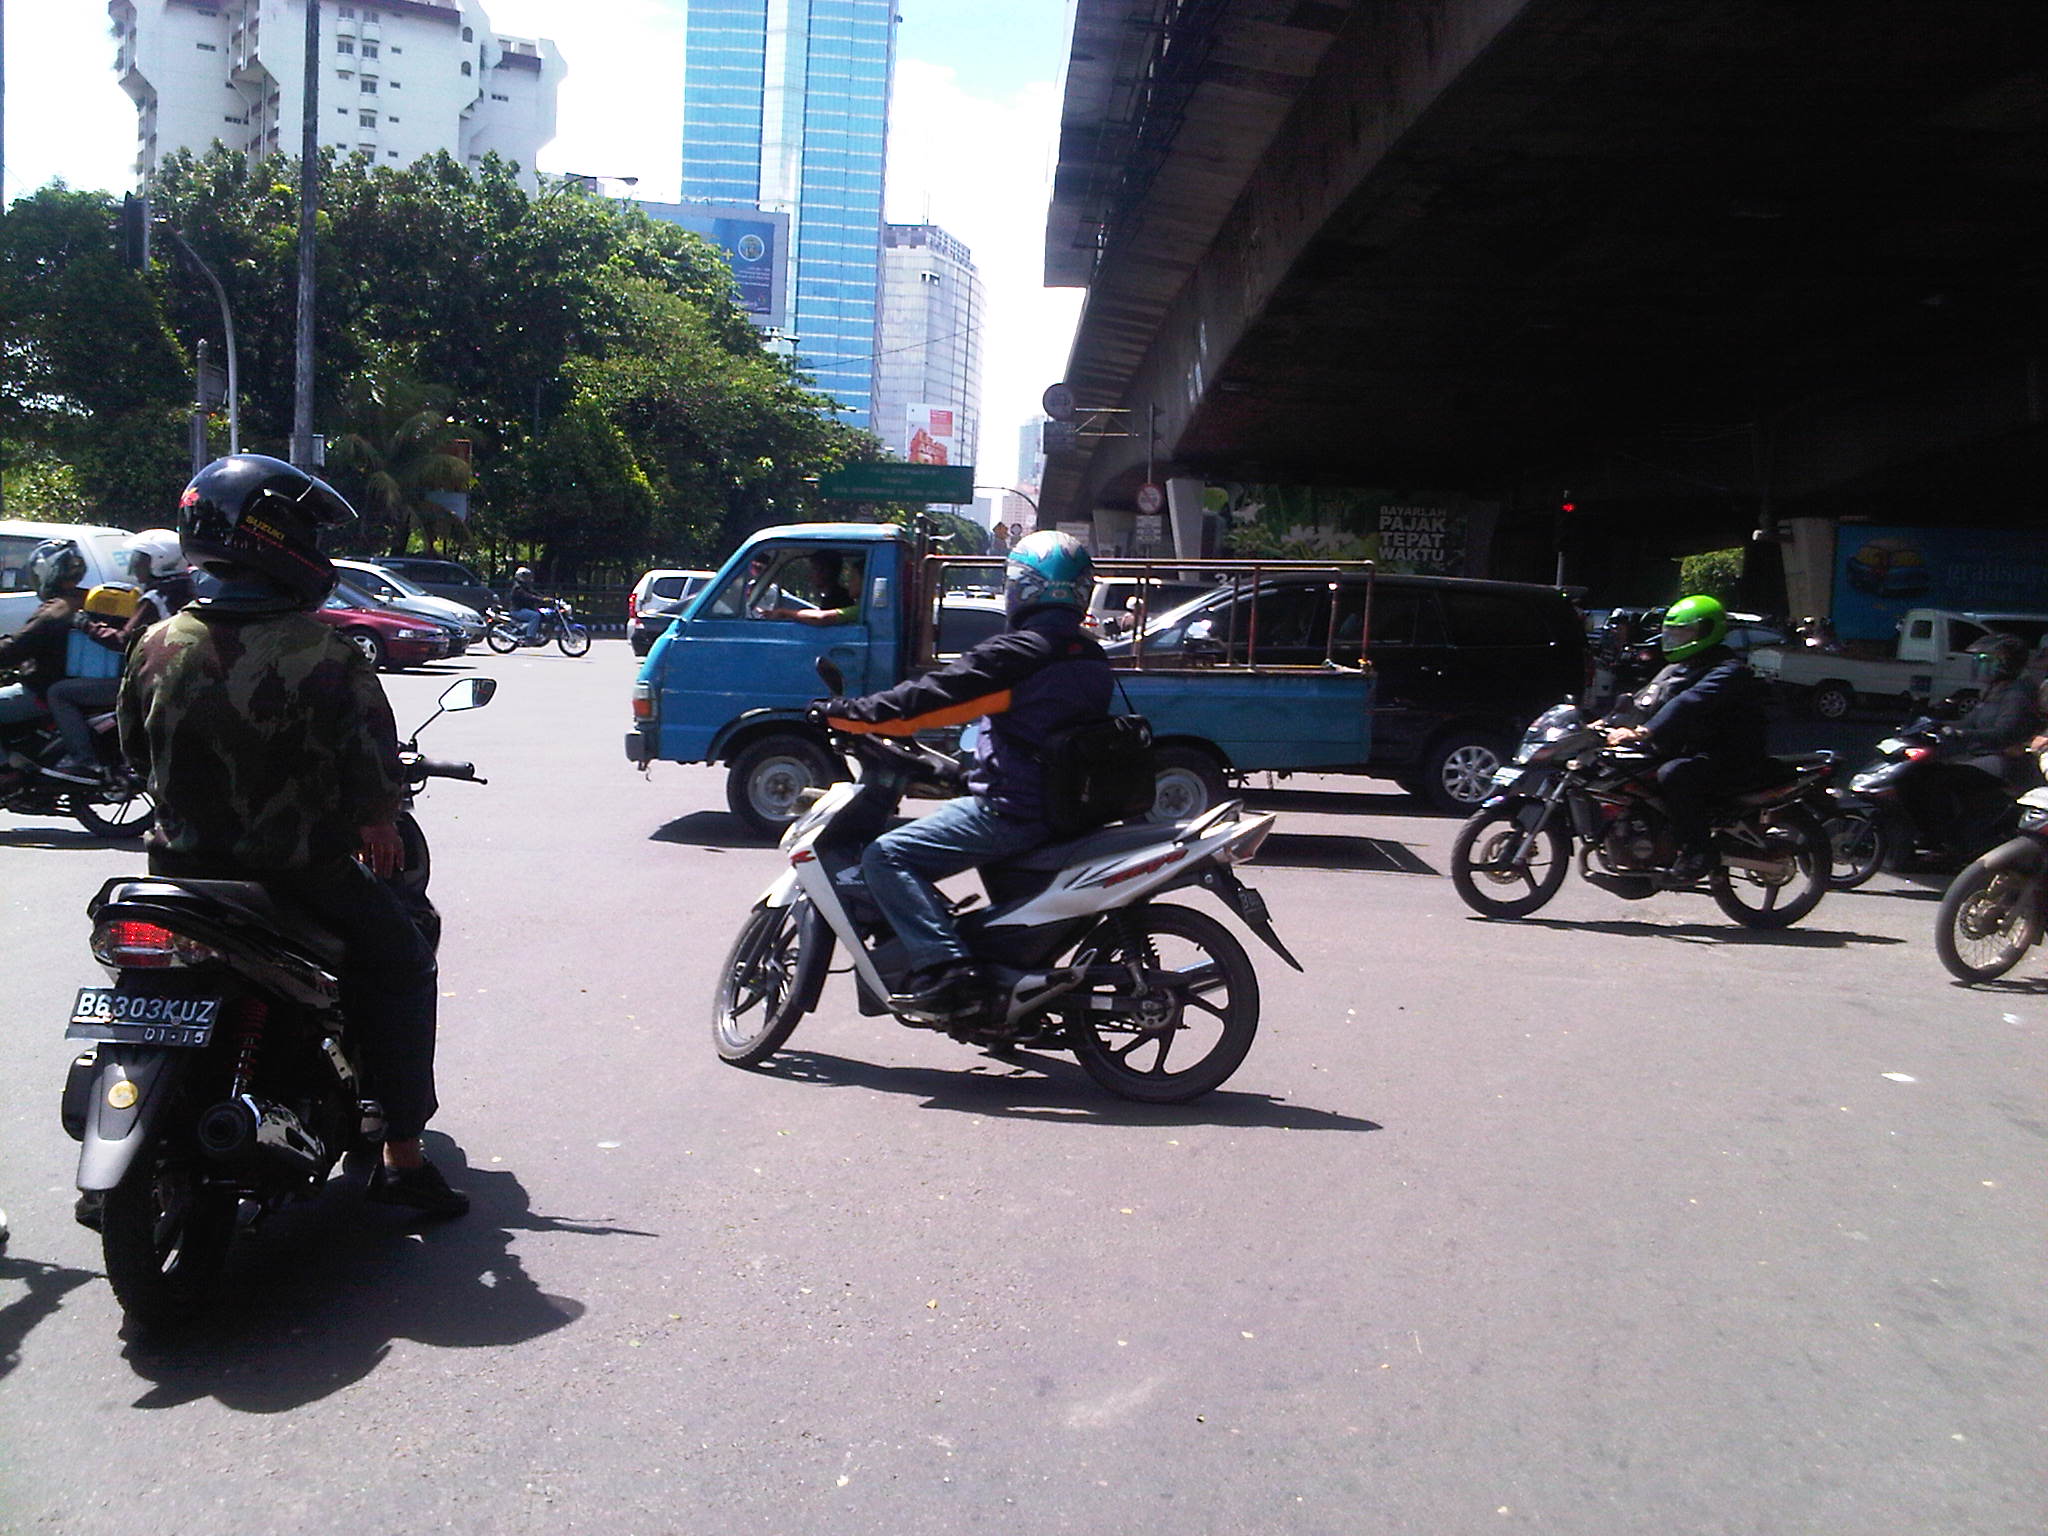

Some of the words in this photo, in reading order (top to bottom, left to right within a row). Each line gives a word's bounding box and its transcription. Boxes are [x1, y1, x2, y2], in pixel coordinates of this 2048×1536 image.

[1380, 515, 1446, 532] PAJAK
[1380, 531, 1445, 548] TEPAT
[1379, 547, 1444, 560] WAKTU
